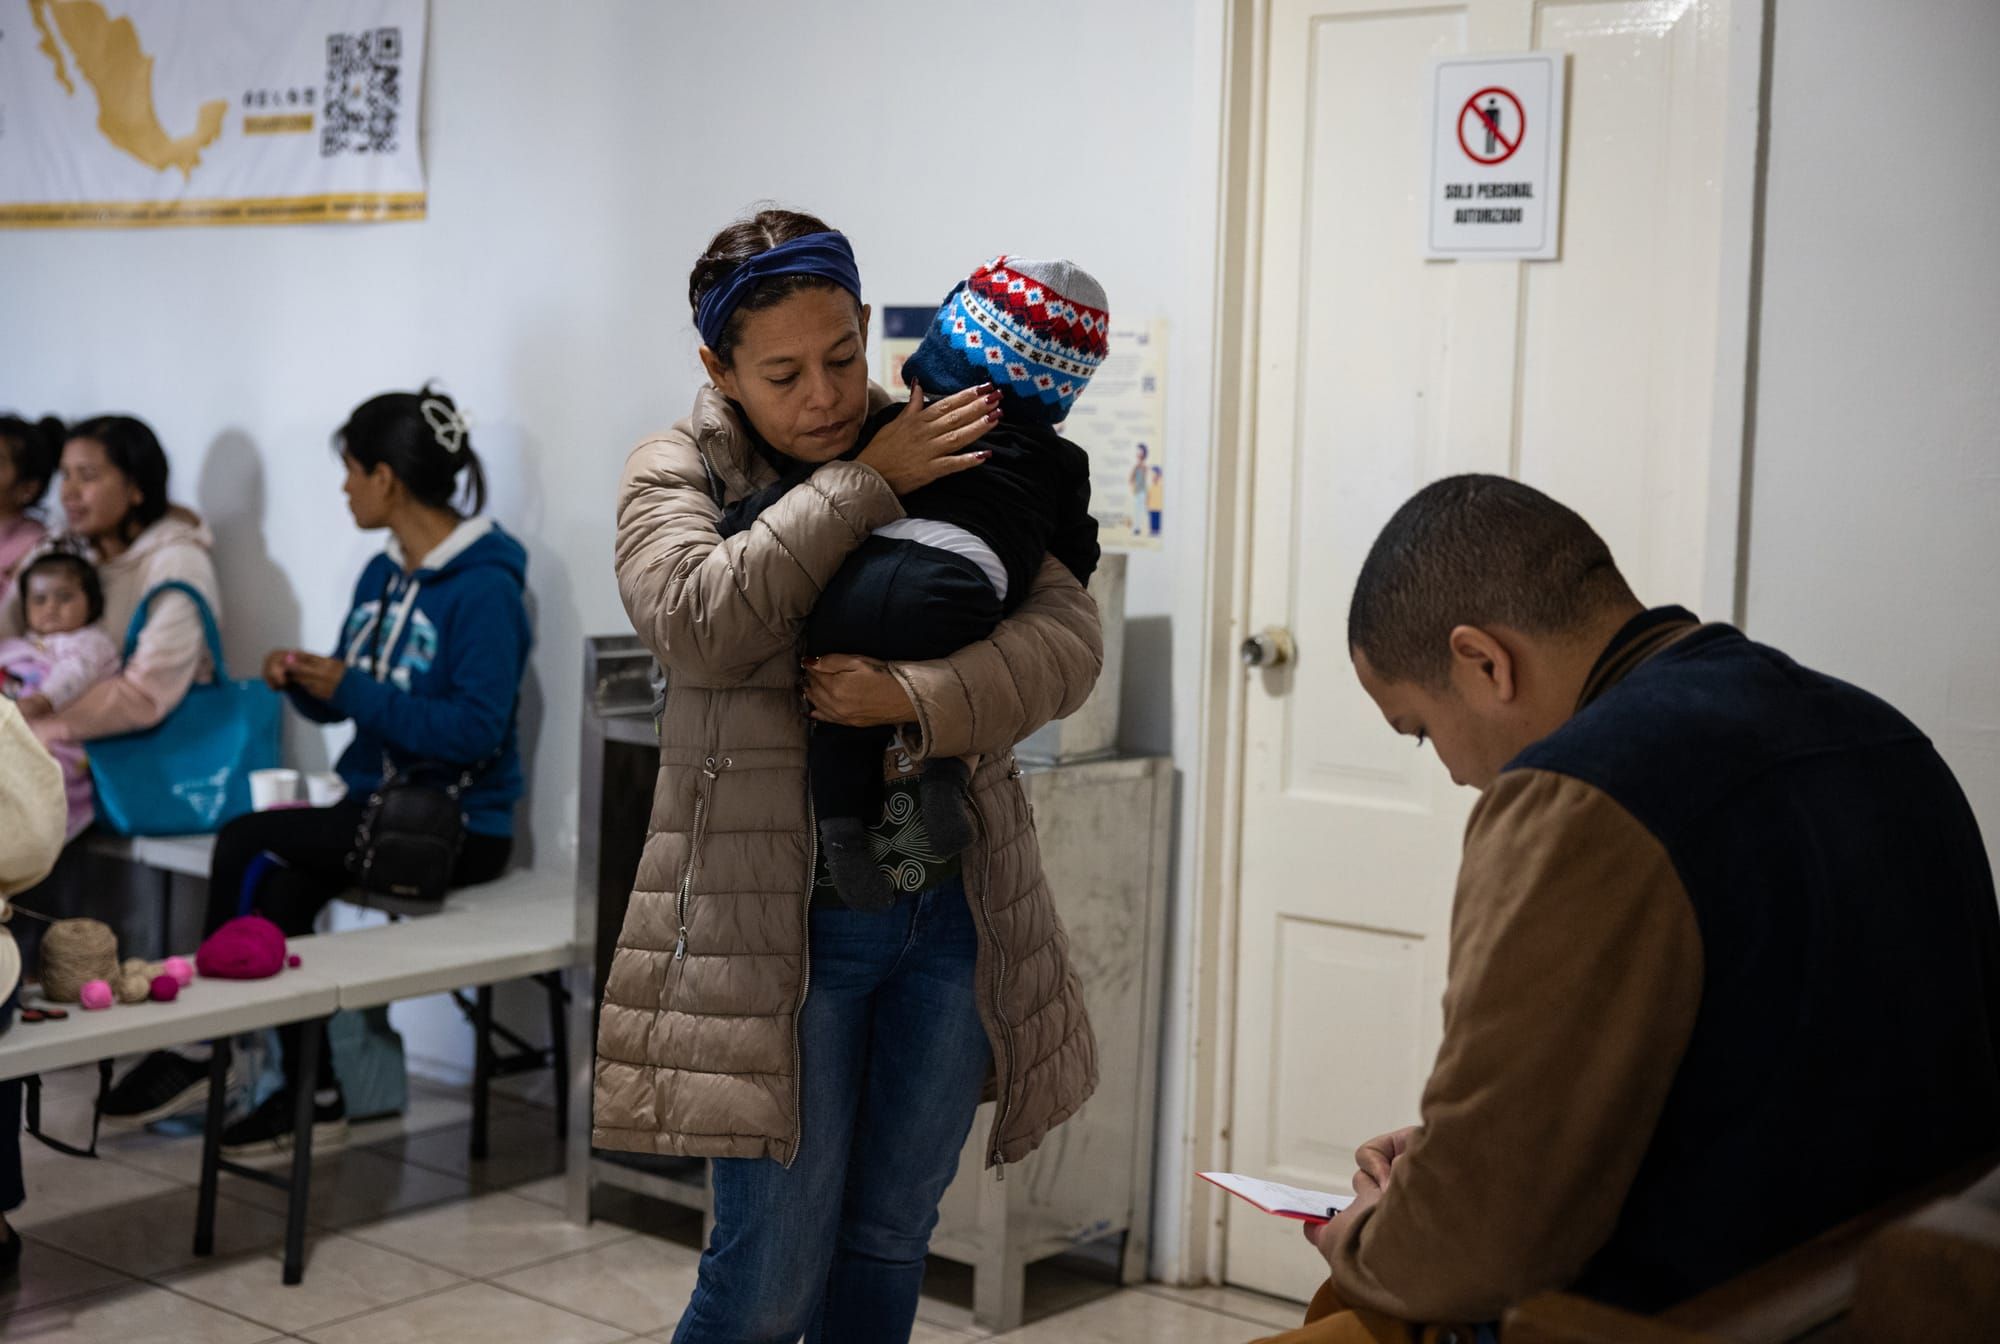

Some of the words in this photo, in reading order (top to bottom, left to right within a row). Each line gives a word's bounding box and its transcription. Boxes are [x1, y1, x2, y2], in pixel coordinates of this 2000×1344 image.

[1445, 184, 1472, 199] SOLO
[1478, 183, 1533, 199] PERSONAL
[1455, 208, 1522, 223] AUTORIZADO
